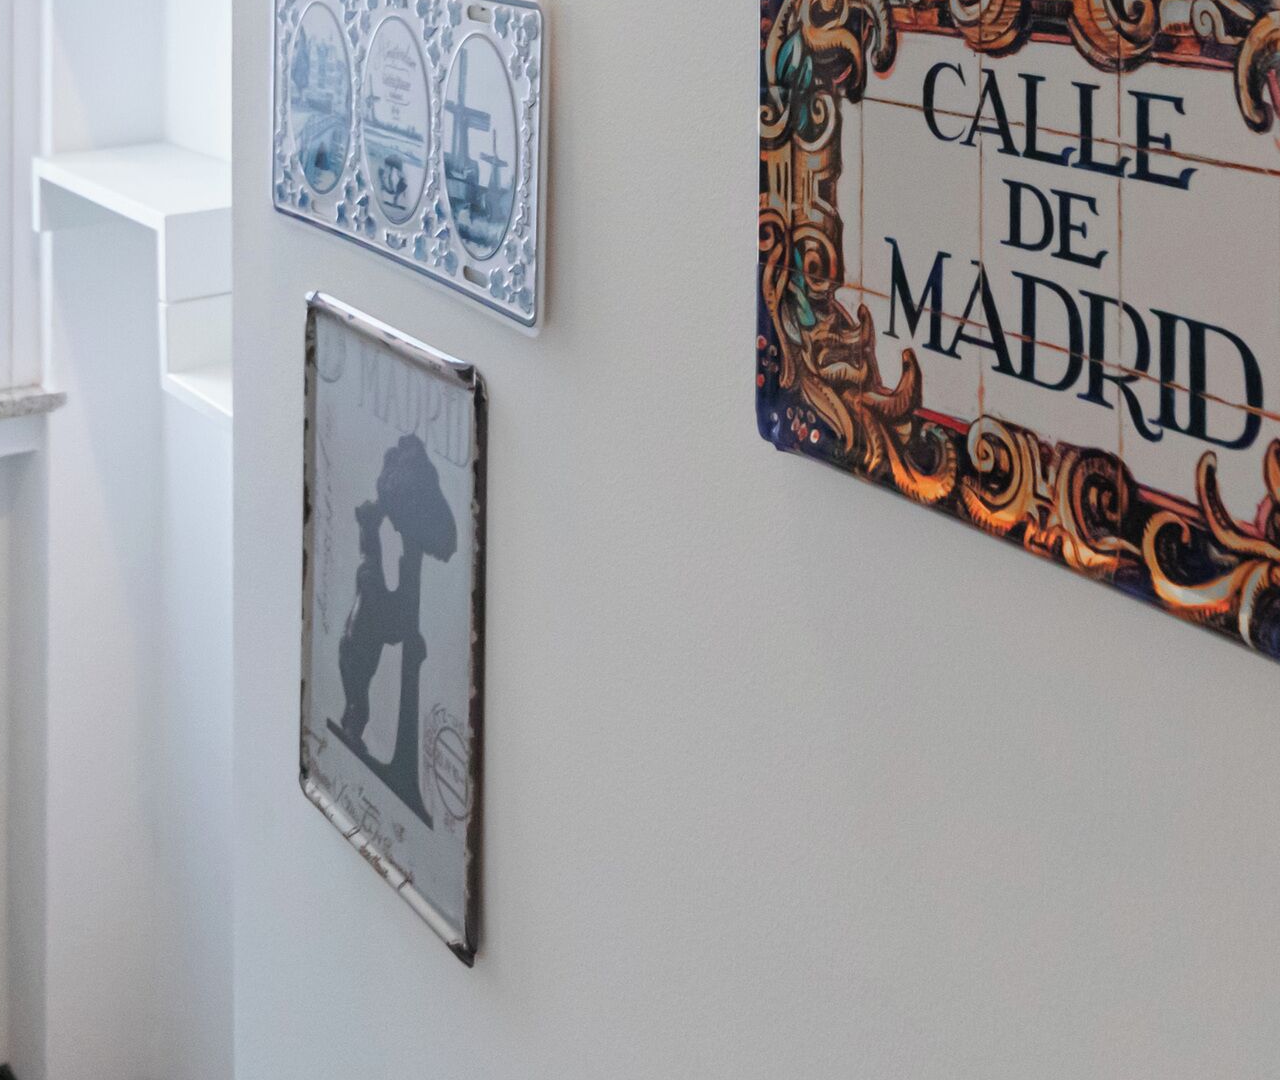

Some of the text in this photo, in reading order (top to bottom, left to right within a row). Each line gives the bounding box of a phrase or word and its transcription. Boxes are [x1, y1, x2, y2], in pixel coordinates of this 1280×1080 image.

[921, 62, 1198, 190] CALLE
[1000, 178, 1108, 269] DE
[882, 236, 1264, 451] MADRID
[357, 345, 473, 468] MADRID
